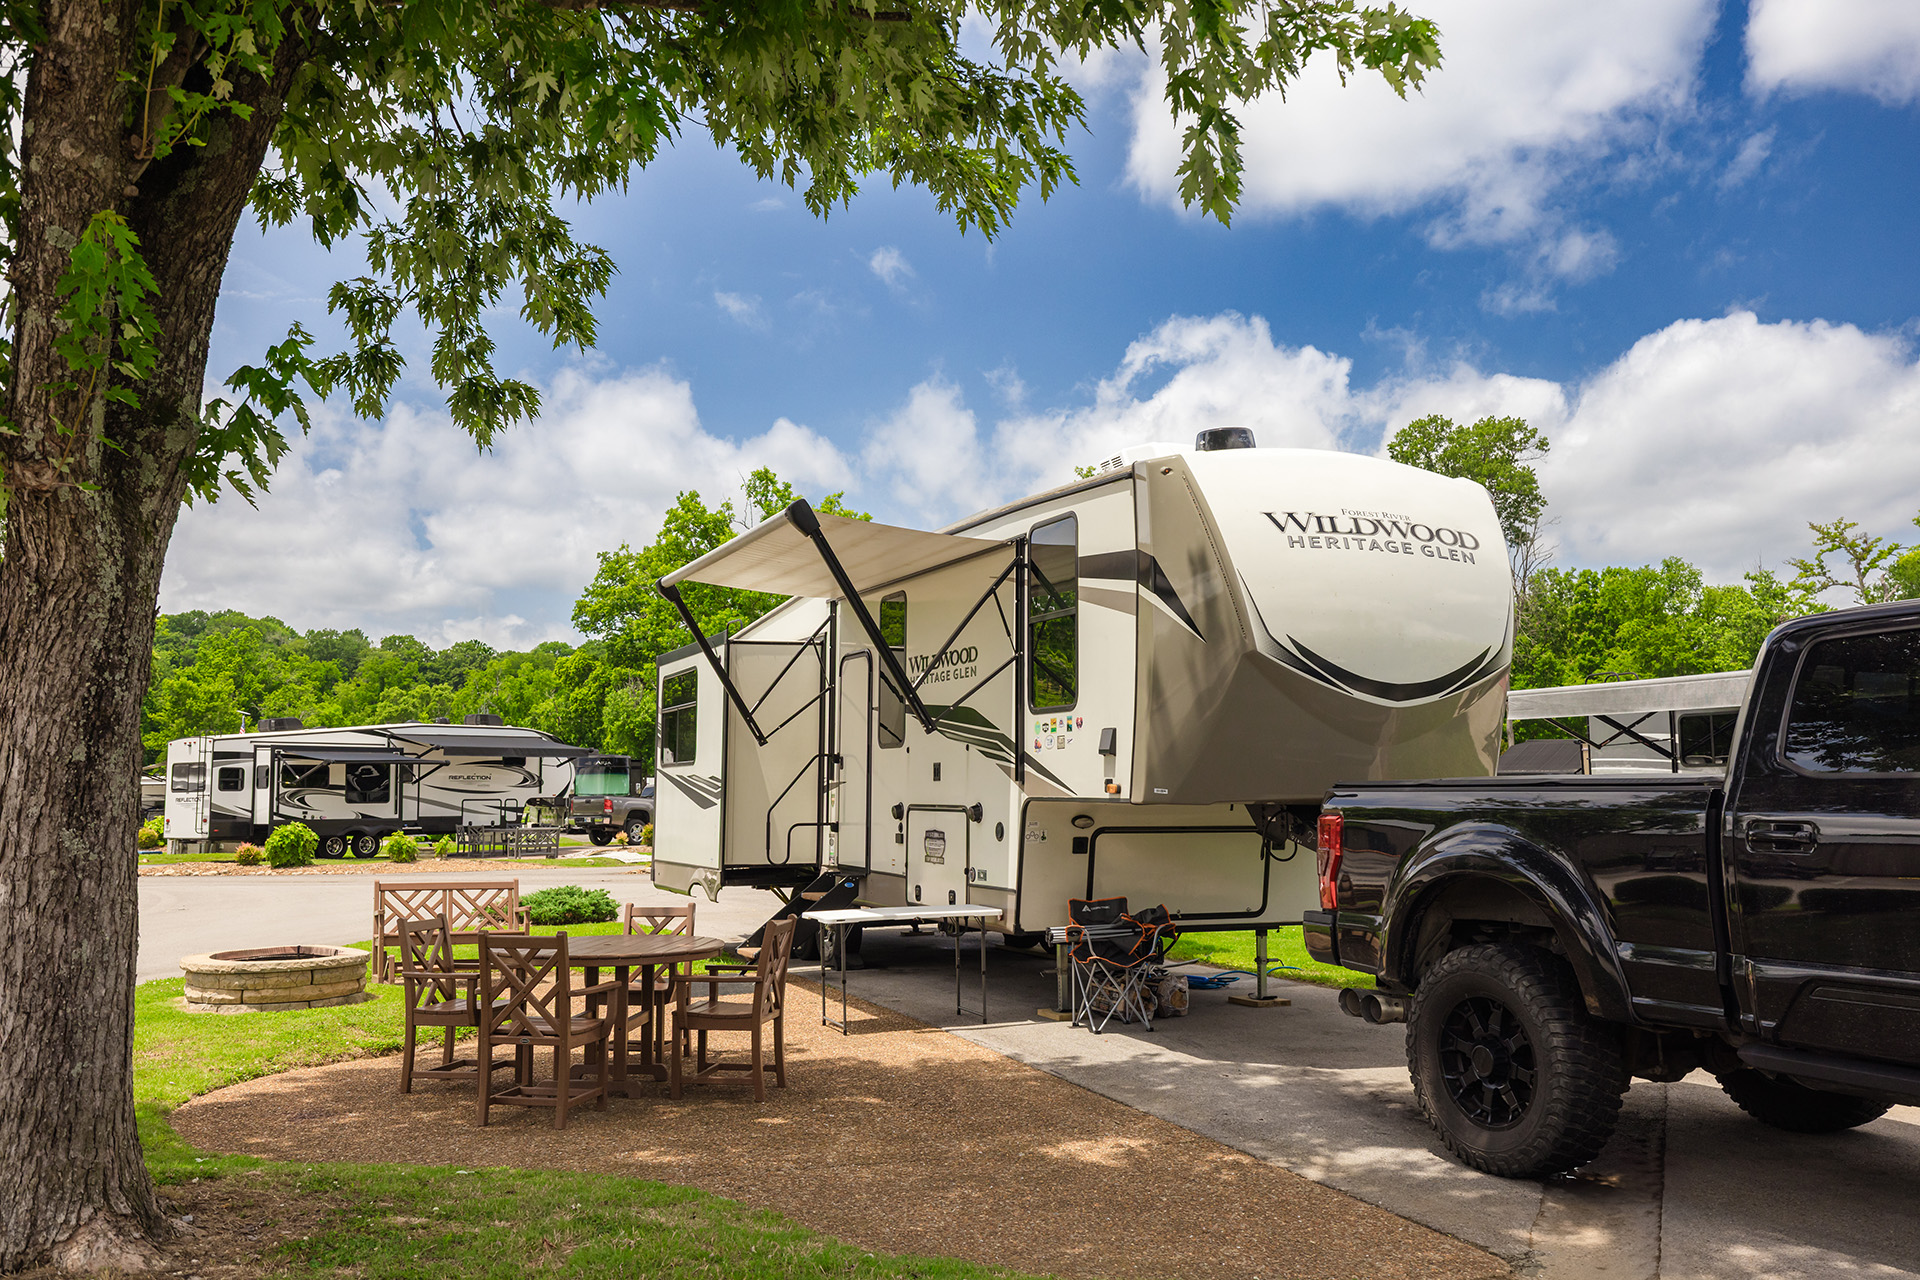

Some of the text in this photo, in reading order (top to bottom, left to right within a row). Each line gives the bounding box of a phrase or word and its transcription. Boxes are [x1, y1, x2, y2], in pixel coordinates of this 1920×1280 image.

[1341, 508, 1411, 521] FOREST RIVER
[1260, 511, 1480, 550] WILDWOOD
[1287, 535, 1475, 565] HERITAGE GLEN
[910, 665, 977, 685] HITAGE GLEN
